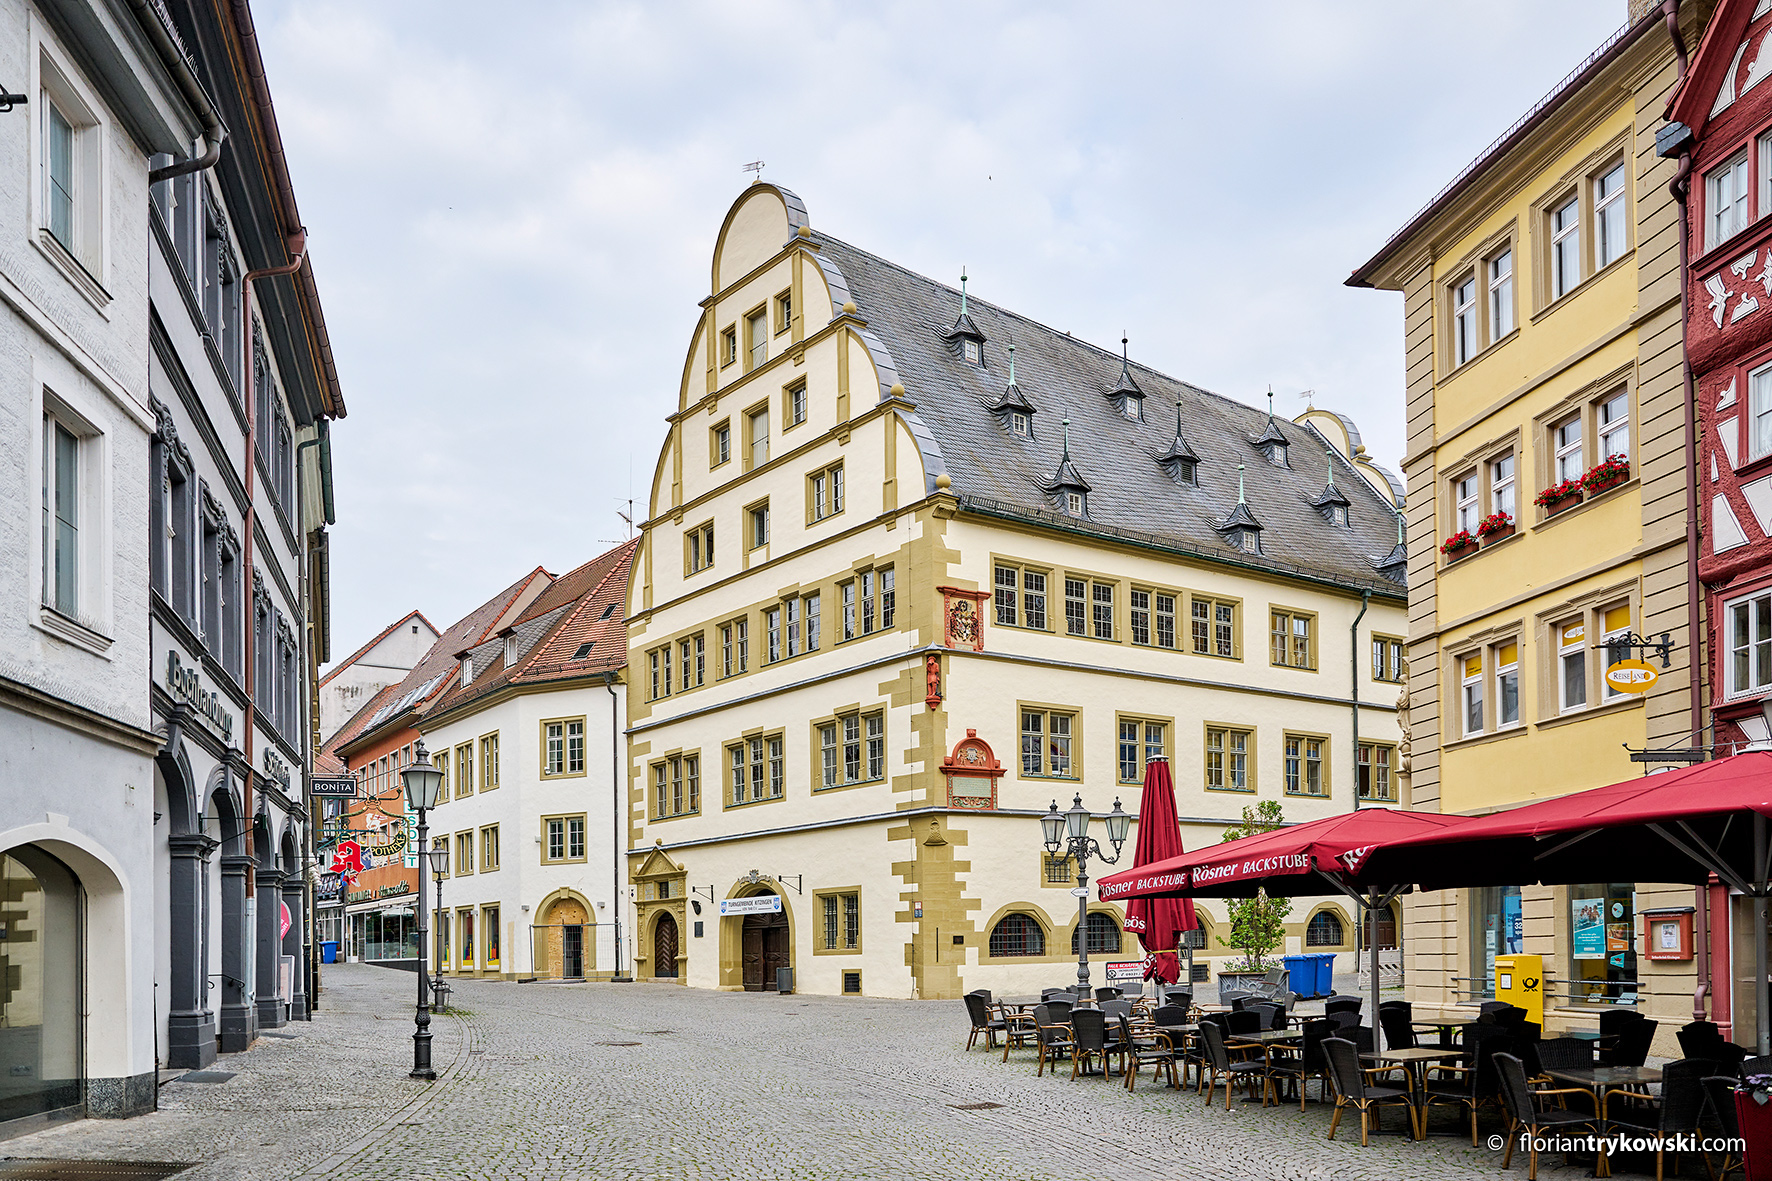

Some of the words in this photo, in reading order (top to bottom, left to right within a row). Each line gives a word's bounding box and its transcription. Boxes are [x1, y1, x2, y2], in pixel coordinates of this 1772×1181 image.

[166, 649, 233, 742] Buchhandlung
[1136, 873, 1186, 891] BACKSTUBE
[1192, 862, 1239, 883] Rösner
[1241, 853, 1309, 874] BACKSTUBE
